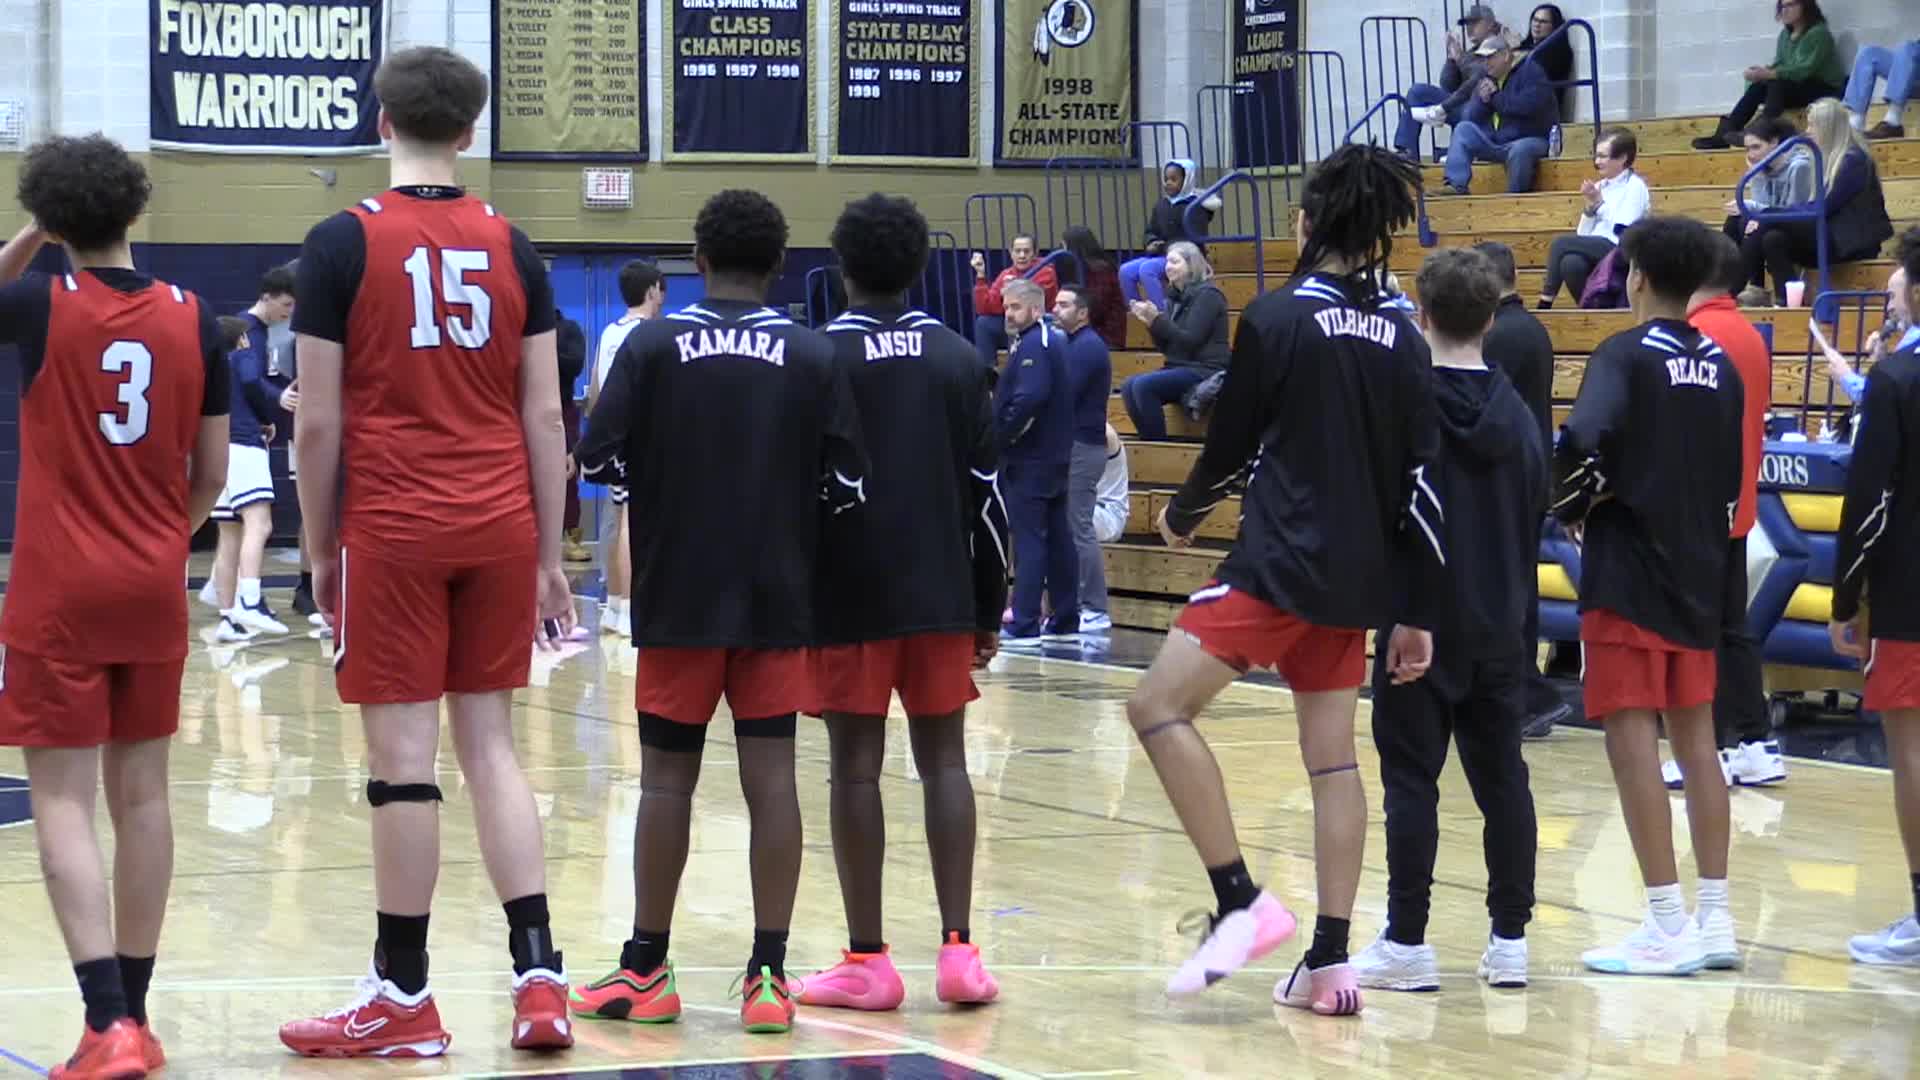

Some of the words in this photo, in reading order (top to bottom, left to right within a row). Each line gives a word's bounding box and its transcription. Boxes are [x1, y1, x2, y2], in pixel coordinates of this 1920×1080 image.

[682, 0, 715, 8] GIRLS
[717, 0, 759, 8] SPRING
[762, 0, 798, 9] TRACK
[849, 2, 880, 13] GIRLS
[882, 3, 924, 15] SPRING
[926, 4, 961, 16] TRACK
[159, 2, 372, 60] FOXBOROUGH
[710, 16, 772, 35] CLASS
[847, 21, 902, 39] STATE
[907, 23, 964, 42] RELAY
[680, 37, 802, 57] CHAMPIONS
[1247, 31, 1284, 52] LEAGUE
[846, 42, 966, 62] CHAMPIONS
[725, 64, 757, 77] 1997
[767, 64, 800, 78] 1998
[889, 68, 921, 81] 1996
[931, 69, 962, 83] 1997
[848, 85, 880, 98] 1998
[1044, 77, 1093, 96] 1998
[173, 71, 359, 130] WARRIORS
[1018, 102, 1120, 121] ALL-STATE
[1009, 127, 1126, 146] CHAMPIONS
[403, 246, 492, 349] 15
[1314, 307, 1396, 349] VILBRUN
[675, 328, 786, 366] KAMARA
[863, 331, 923, 361] ANSU
[100, 339, 152, 446] 3
